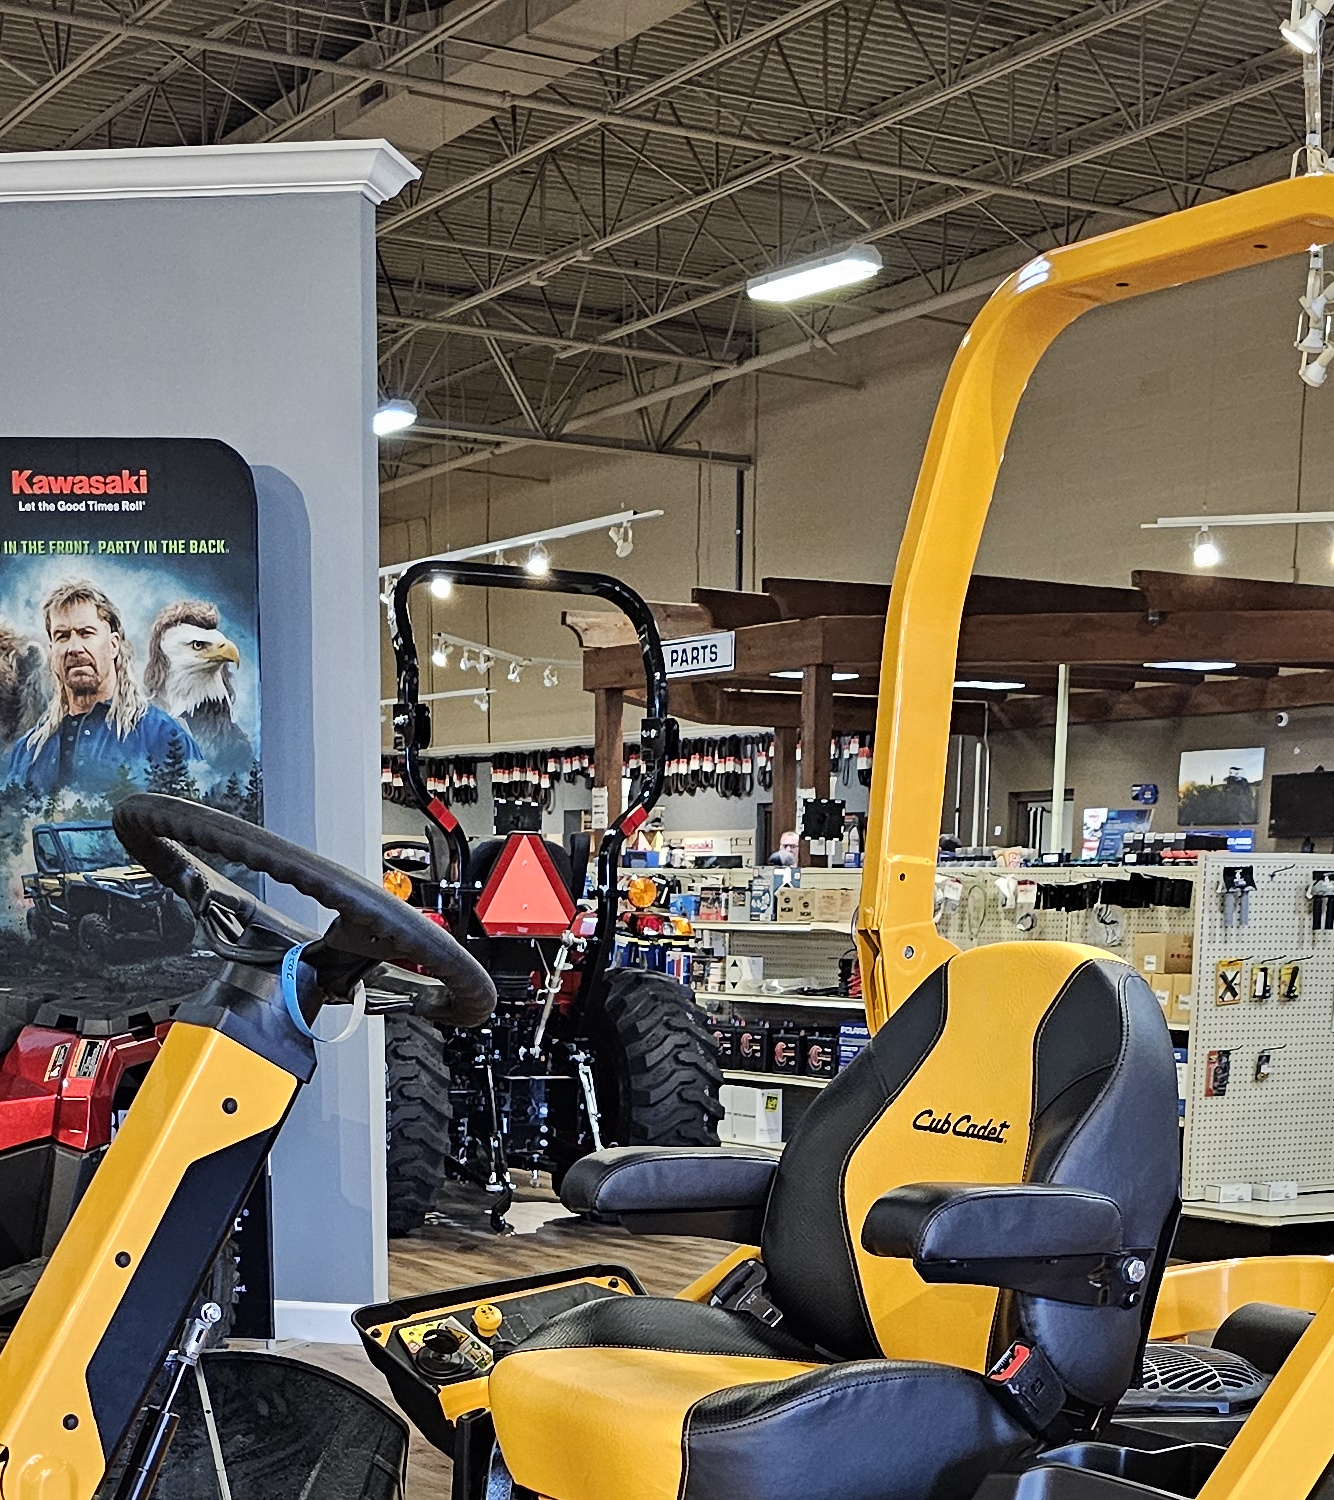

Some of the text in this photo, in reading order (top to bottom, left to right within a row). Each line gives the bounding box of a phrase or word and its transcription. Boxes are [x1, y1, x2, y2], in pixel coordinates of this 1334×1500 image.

[11, 469, 148, 495] Kawasaki
[18, 501, 36, 512] Let
[38, 501, 56, 512] the
[57, 501, 86, 512] Good
[87, 501, 120, 512] Times
[4, 541, 17, 555] IN
[20, 540, 46, 555] THE
[49, 540, 95, 555] FRONT.
[98, 540, 140, 554] PARTY
[144, 540, 157, 554] IN
[161, 540, 186, 553] THE
[189, 539, 230, 554] BACK.
[669, 642, 720, 669] PARTS
[912, 1109, 1011, 1144] Cub Cadet
